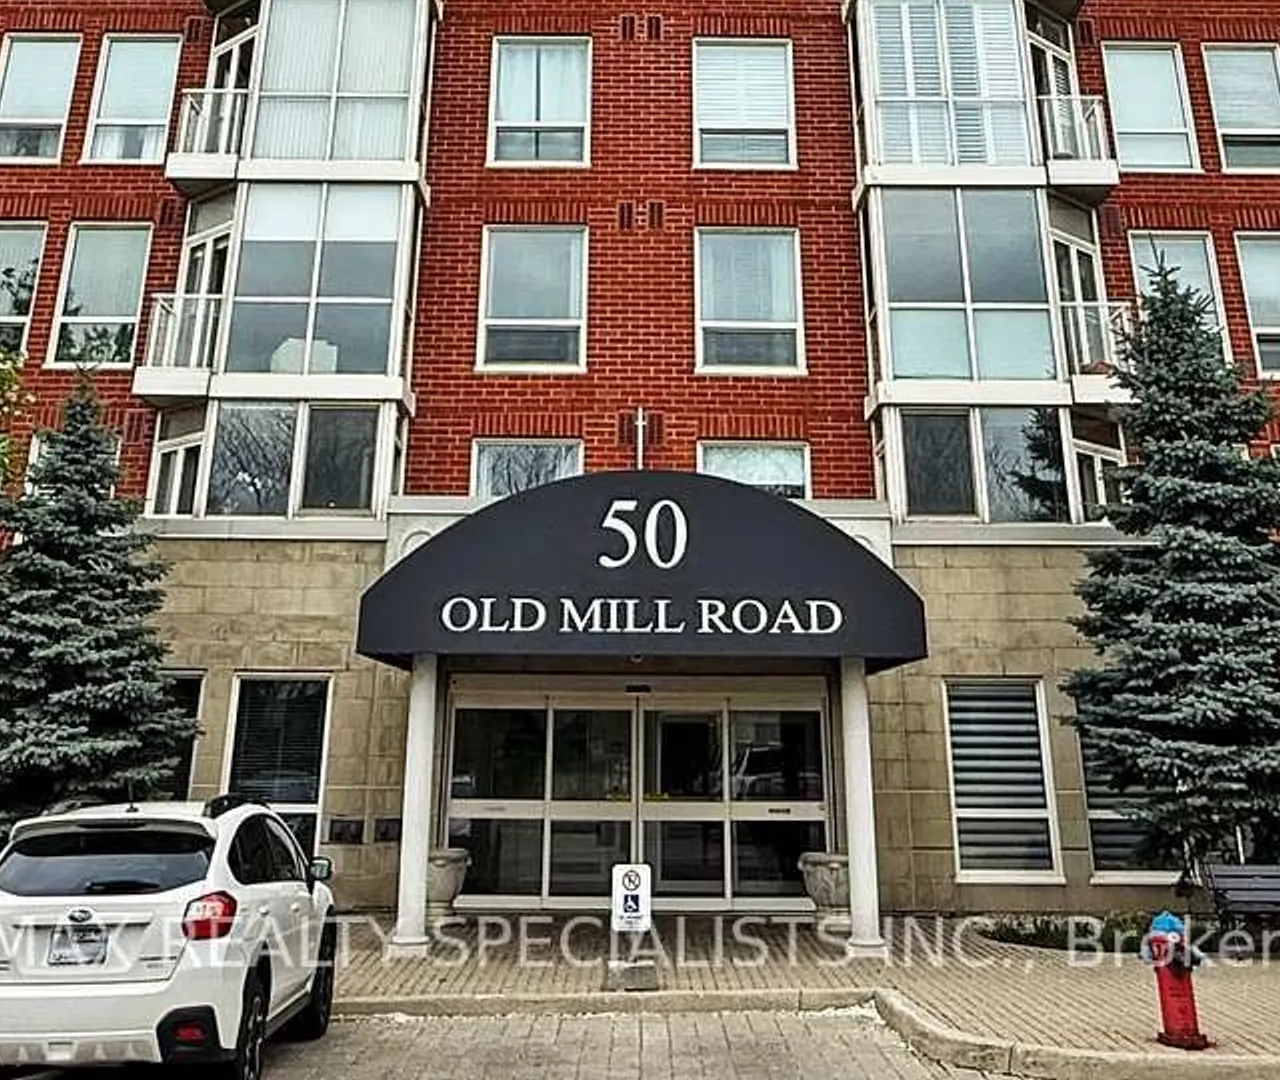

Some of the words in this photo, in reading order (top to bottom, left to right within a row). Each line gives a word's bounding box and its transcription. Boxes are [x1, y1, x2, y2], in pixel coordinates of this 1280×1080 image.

[597, 498, 689, 570] 50
[440, 596, 547, 633] OLD
[559, 597, 686, 634] MILL
[696, 598, 844, 635] ROAD
